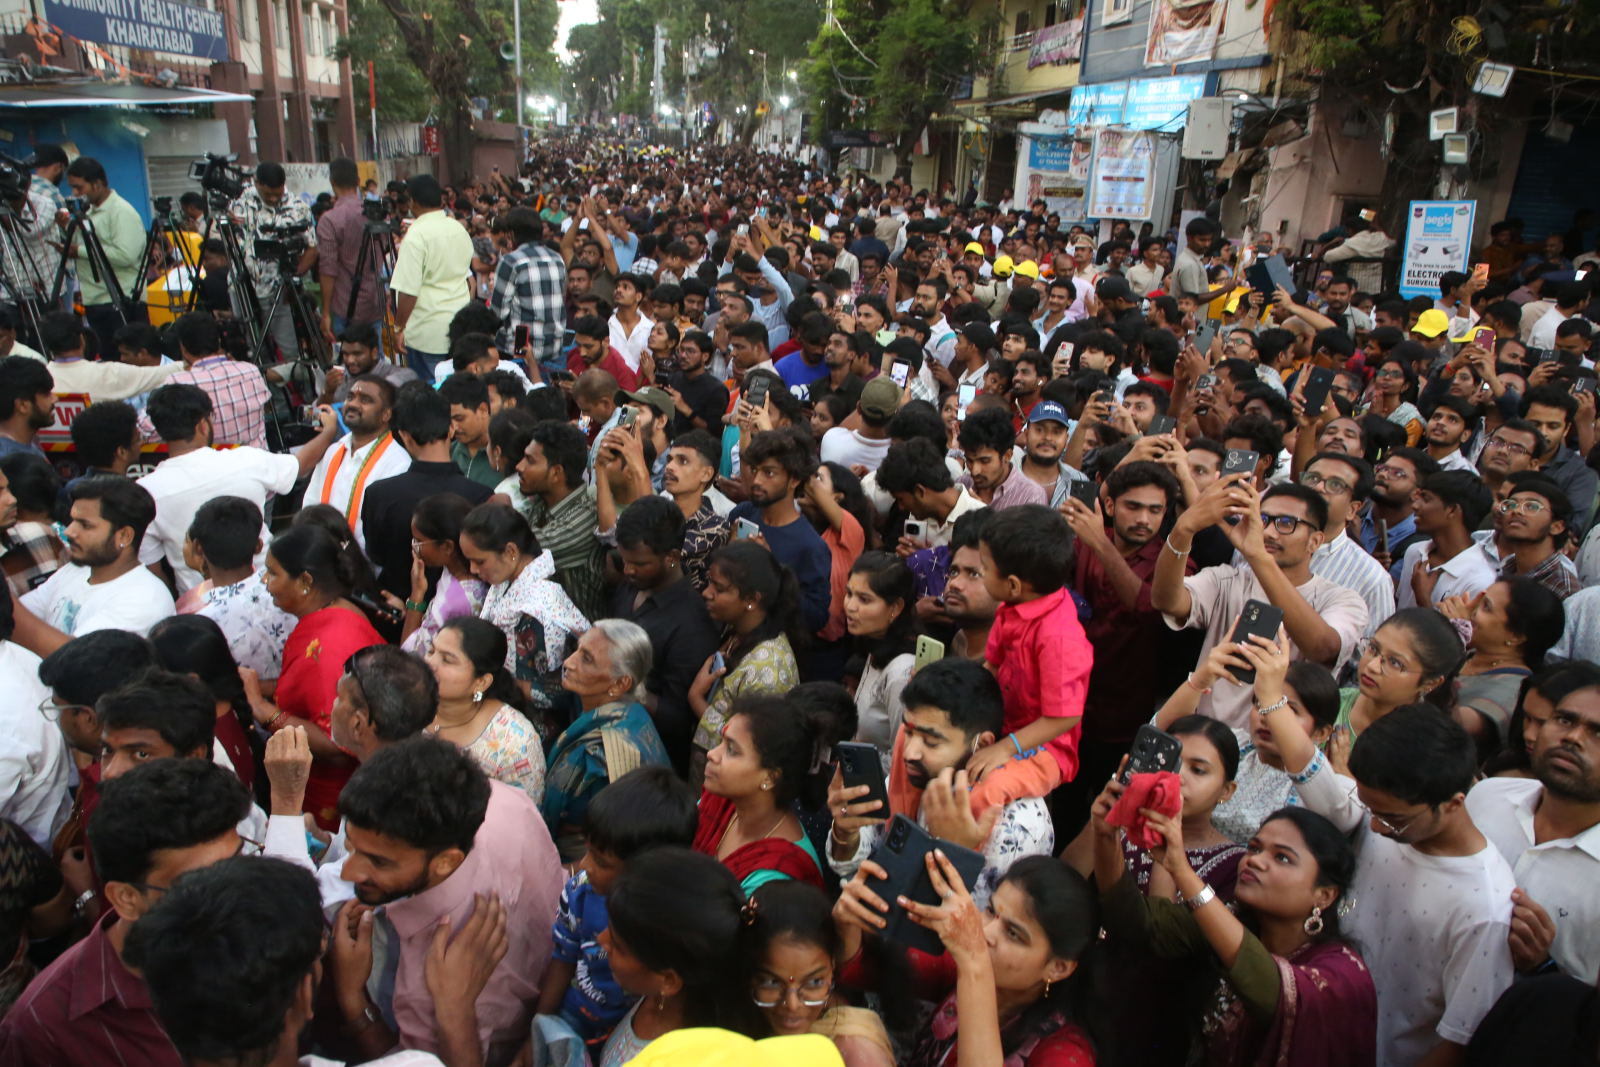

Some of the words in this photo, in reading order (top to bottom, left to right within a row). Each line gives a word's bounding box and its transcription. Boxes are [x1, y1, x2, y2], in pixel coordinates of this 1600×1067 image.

[106, 18, 194, 54] KHAIRATABAD
[140, 0, 184, 30] HEALTH
[185, 7, 223, 38] CENTRE
